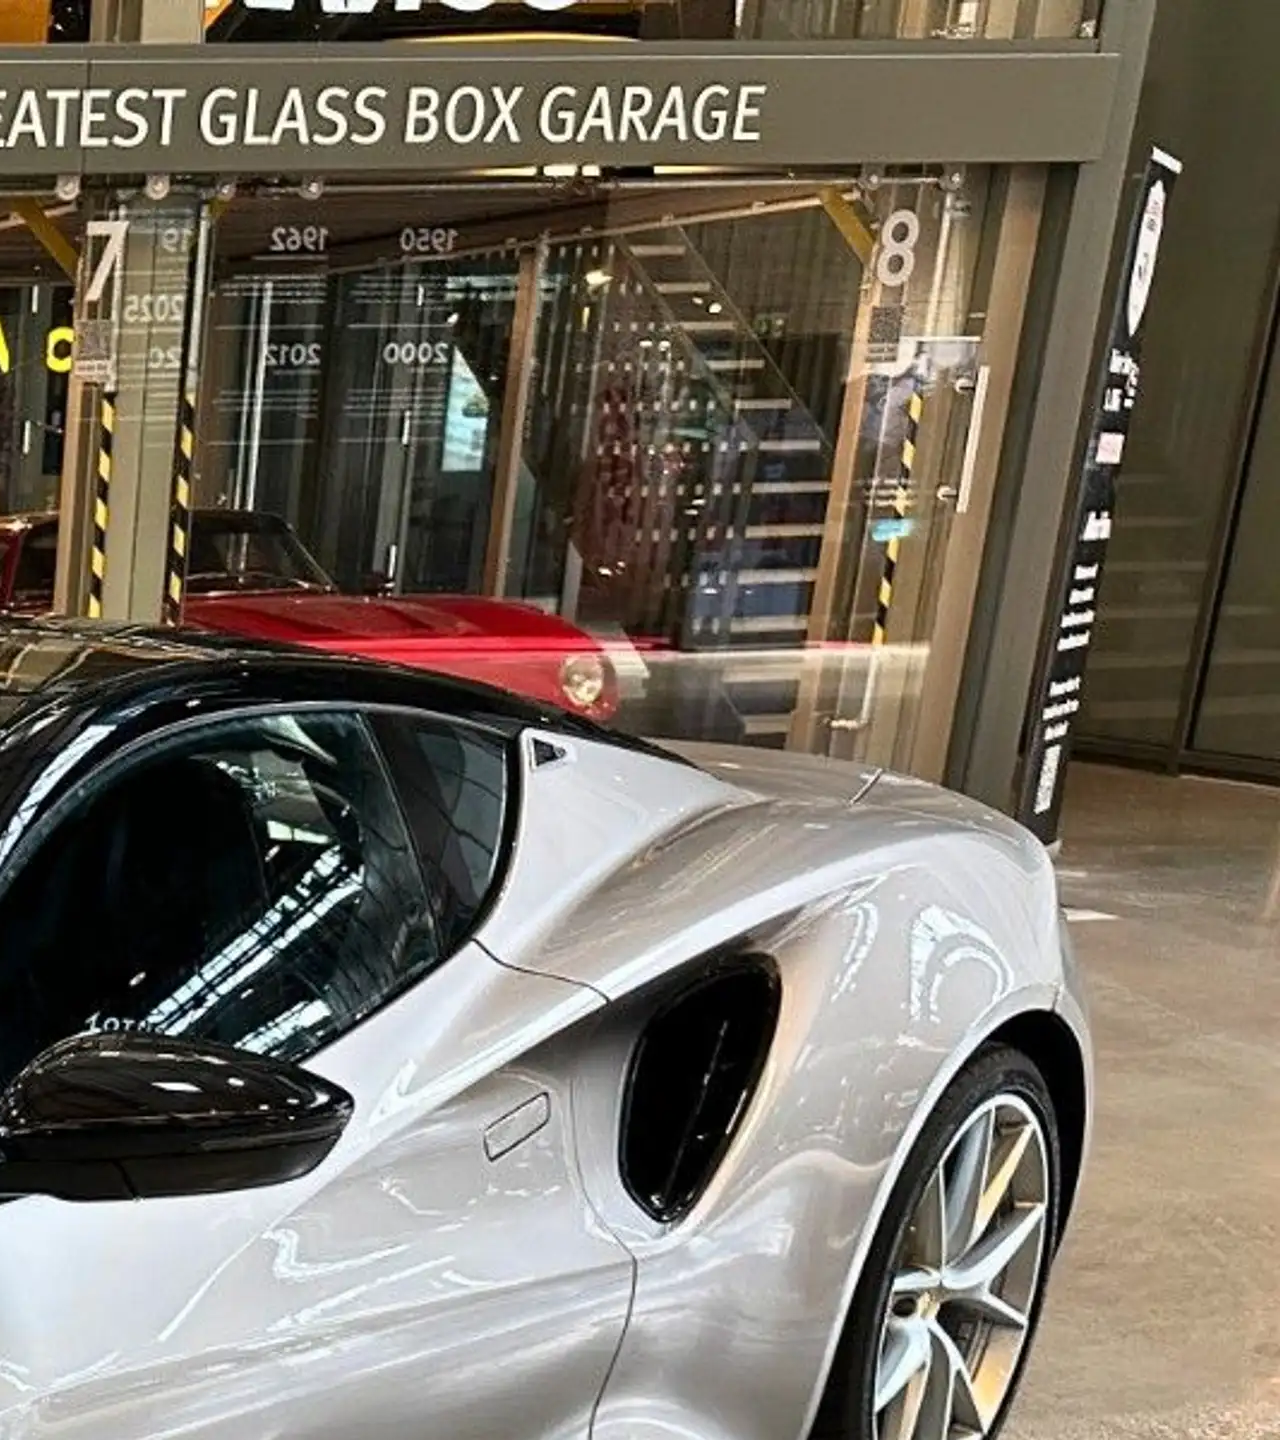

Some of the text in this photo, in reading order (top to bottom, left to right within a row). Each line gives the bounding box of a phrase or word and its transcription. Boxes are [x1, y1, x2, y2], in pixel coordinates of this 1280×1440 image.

[198, 86, 388, 146] GLASS
[403, 85, 525, 144] BOX
[539, 84, 768, 141] GARAGE
[86, 220, 130, 302] 7
[877, 208, 920, 287] 8
